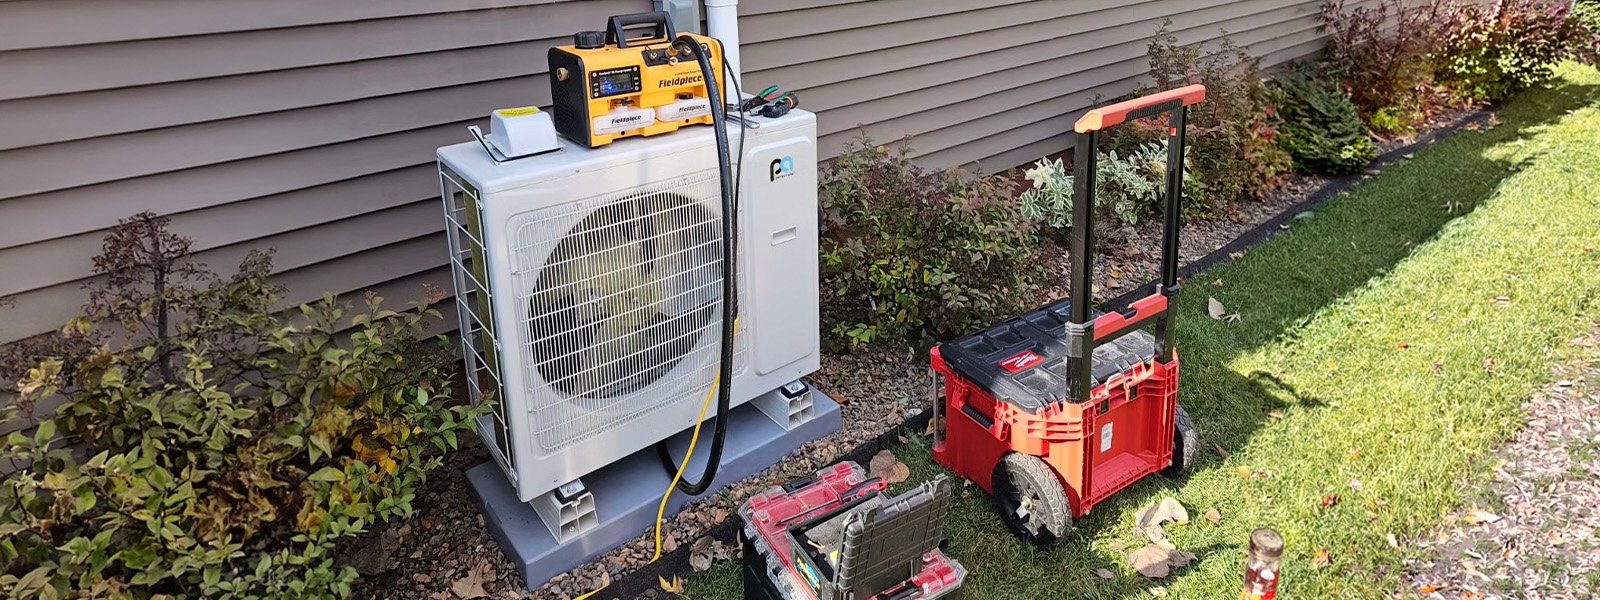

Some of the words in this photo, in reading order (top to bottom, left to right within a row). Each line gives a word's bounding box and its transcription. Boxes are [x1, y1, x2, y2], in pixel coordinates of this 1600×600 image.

[658, 75, 703, 88] Fieldpiece
[679, 104, 705, 113] Fieldpiece
[611, 115, 642, 124] Fieldpiece
